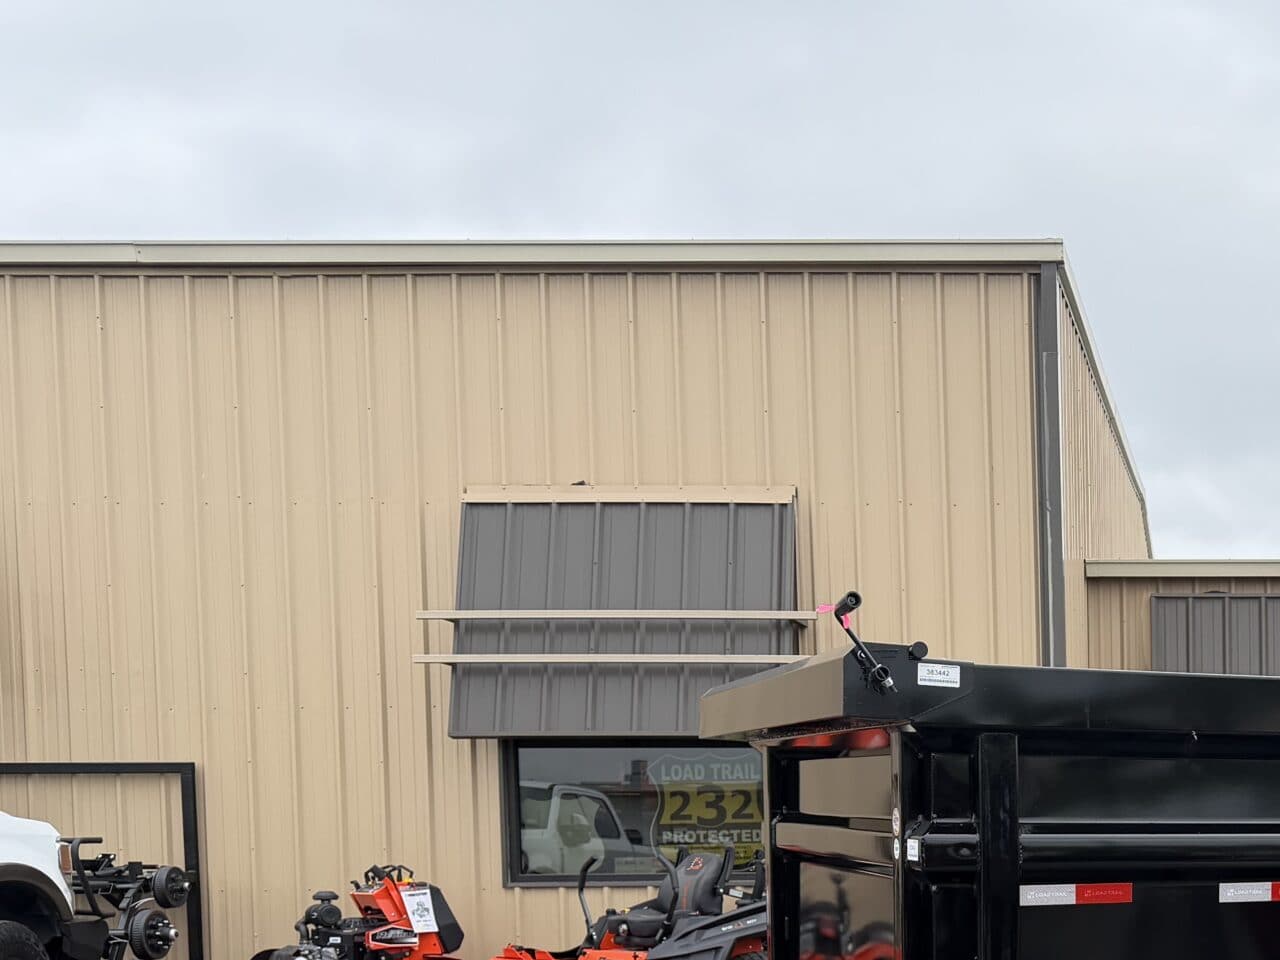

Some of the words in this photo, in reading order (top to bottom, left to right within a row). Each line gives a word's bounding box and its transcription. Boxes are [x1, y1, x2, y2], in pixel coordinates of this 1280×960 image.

[661, 764, 705, 780] LOAD
[710, 763, 760, 780] TRAIL
[669, 785, 755, 828] 232
[662, 829, 761, 843] PROTECTED
